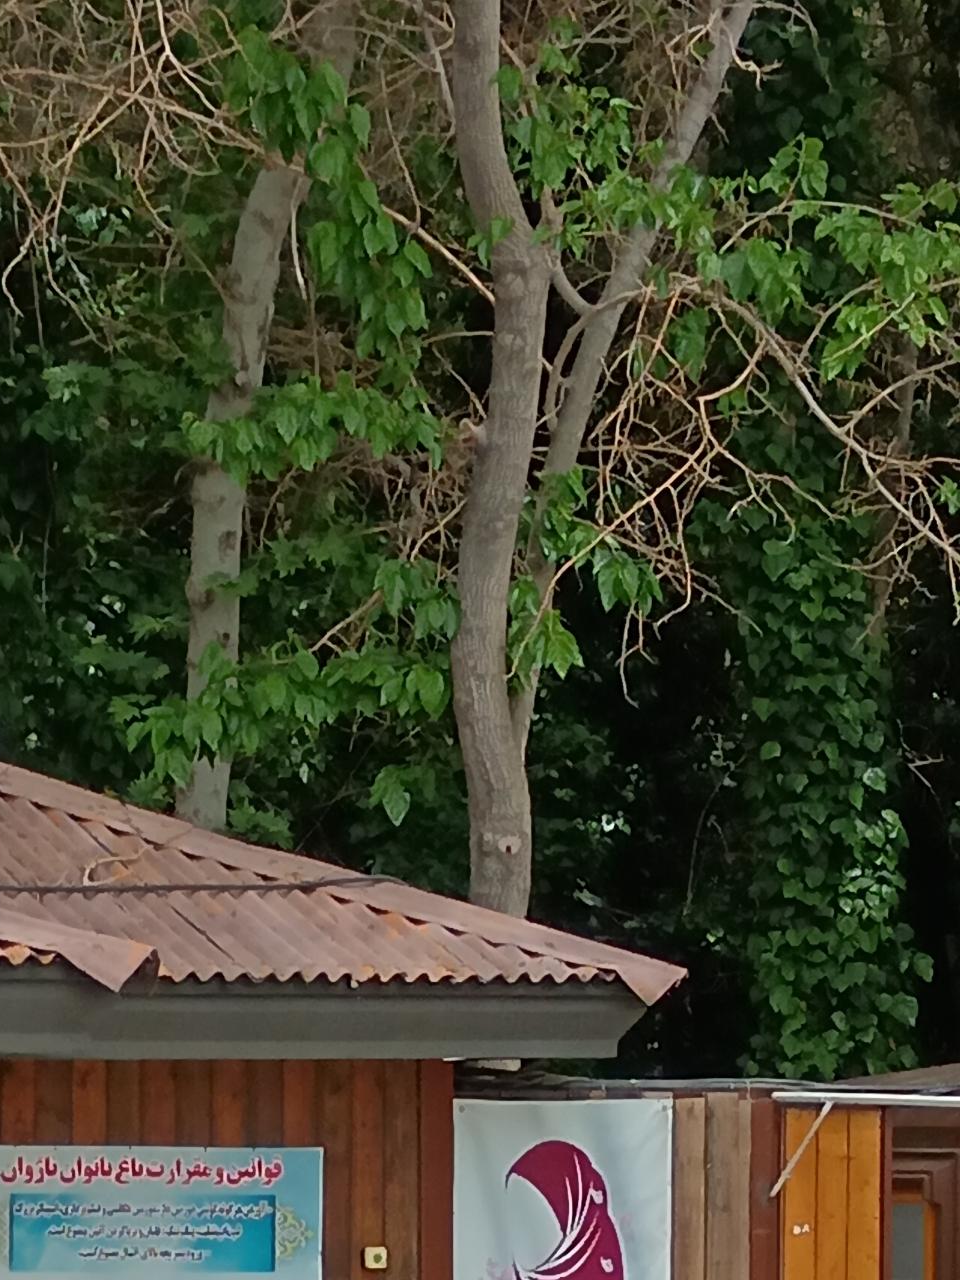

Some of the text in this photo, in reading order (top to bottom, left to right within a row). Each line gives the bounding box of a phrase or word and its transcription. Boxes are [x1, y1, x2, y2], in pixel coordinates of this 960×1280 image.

[0, 1155, 58, 1184] ناژوان
[60, 1155, 113, 1184] بانوان
[114, 1155, 144, 1185] باغ
[213, 1166, 224, 1185] و
[227, 1155, 282, 1185] قوانین
